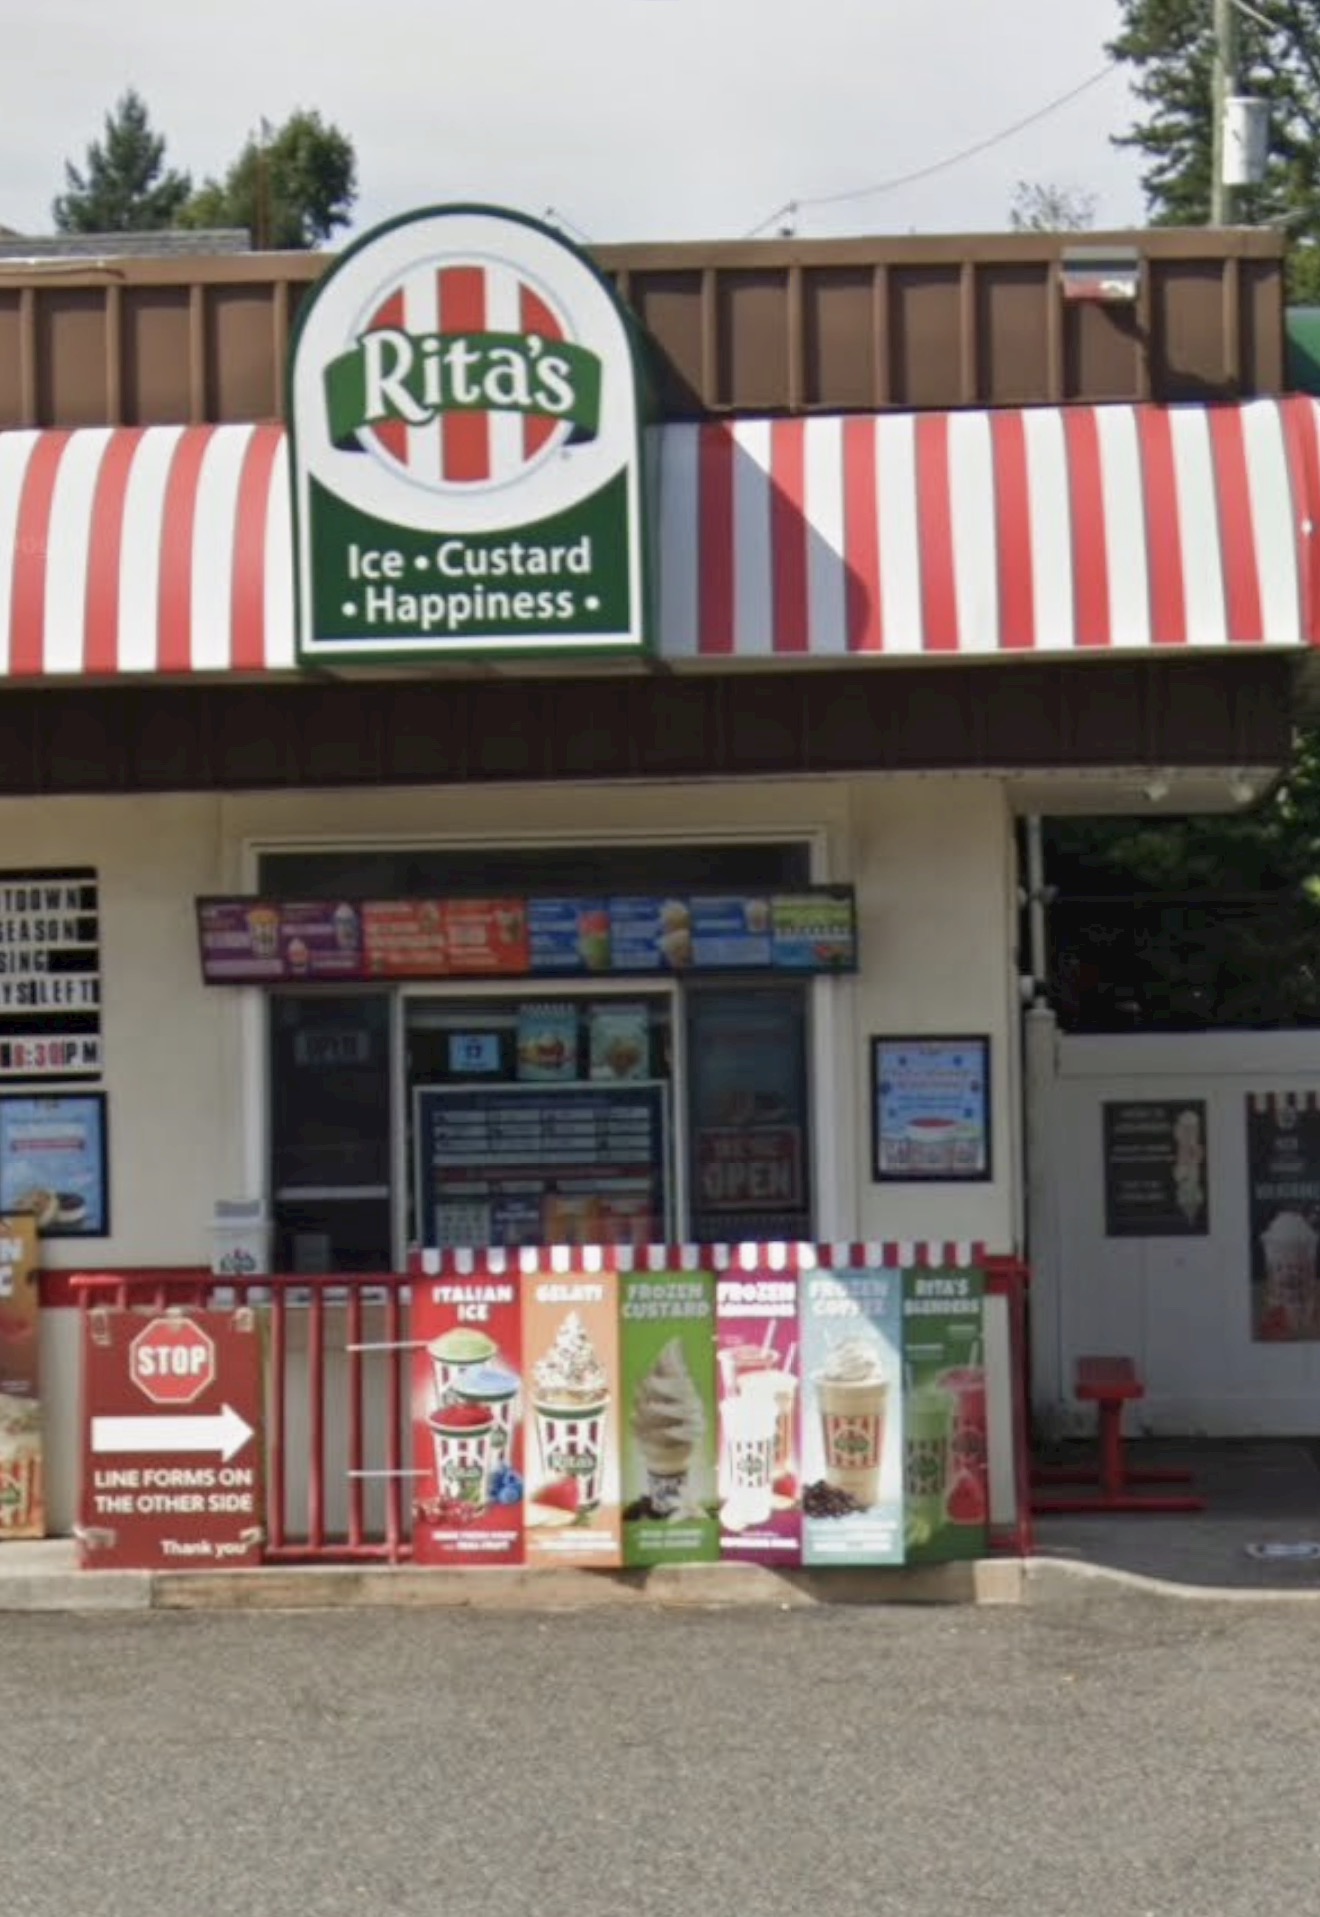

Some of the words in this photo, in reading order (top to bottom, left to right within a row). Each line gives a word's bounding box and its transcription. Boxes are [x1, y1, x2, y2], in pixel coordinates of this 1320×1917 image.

[361, 331, 576, 424] Rita's
[348, 543, 404, 580] Ice
[436, 535, 592, 577] Custard
[365, 584, 575, 630] Happiness
[433, 1286, 513, 1303] ITALIAN
[628, 1284, 702, 1301] FROZEN
[457, 1304, 488, 1321] ICE
[622, 1302, 709, 1319] CUSTARD
[137, 1346, 206, 1376] STOP
[95, 1470, 139, 1487] LINE
[143, 1469, 214, 1487] FORMS
[219, 1468, 252, 1486] ON
[95, 1495, 133, 1513] THE
[136, 1494, 204, 1513] OTHER
[208, 1493, 253, 1513] SIDE
[161, 1540, 212, 1556] Thank
